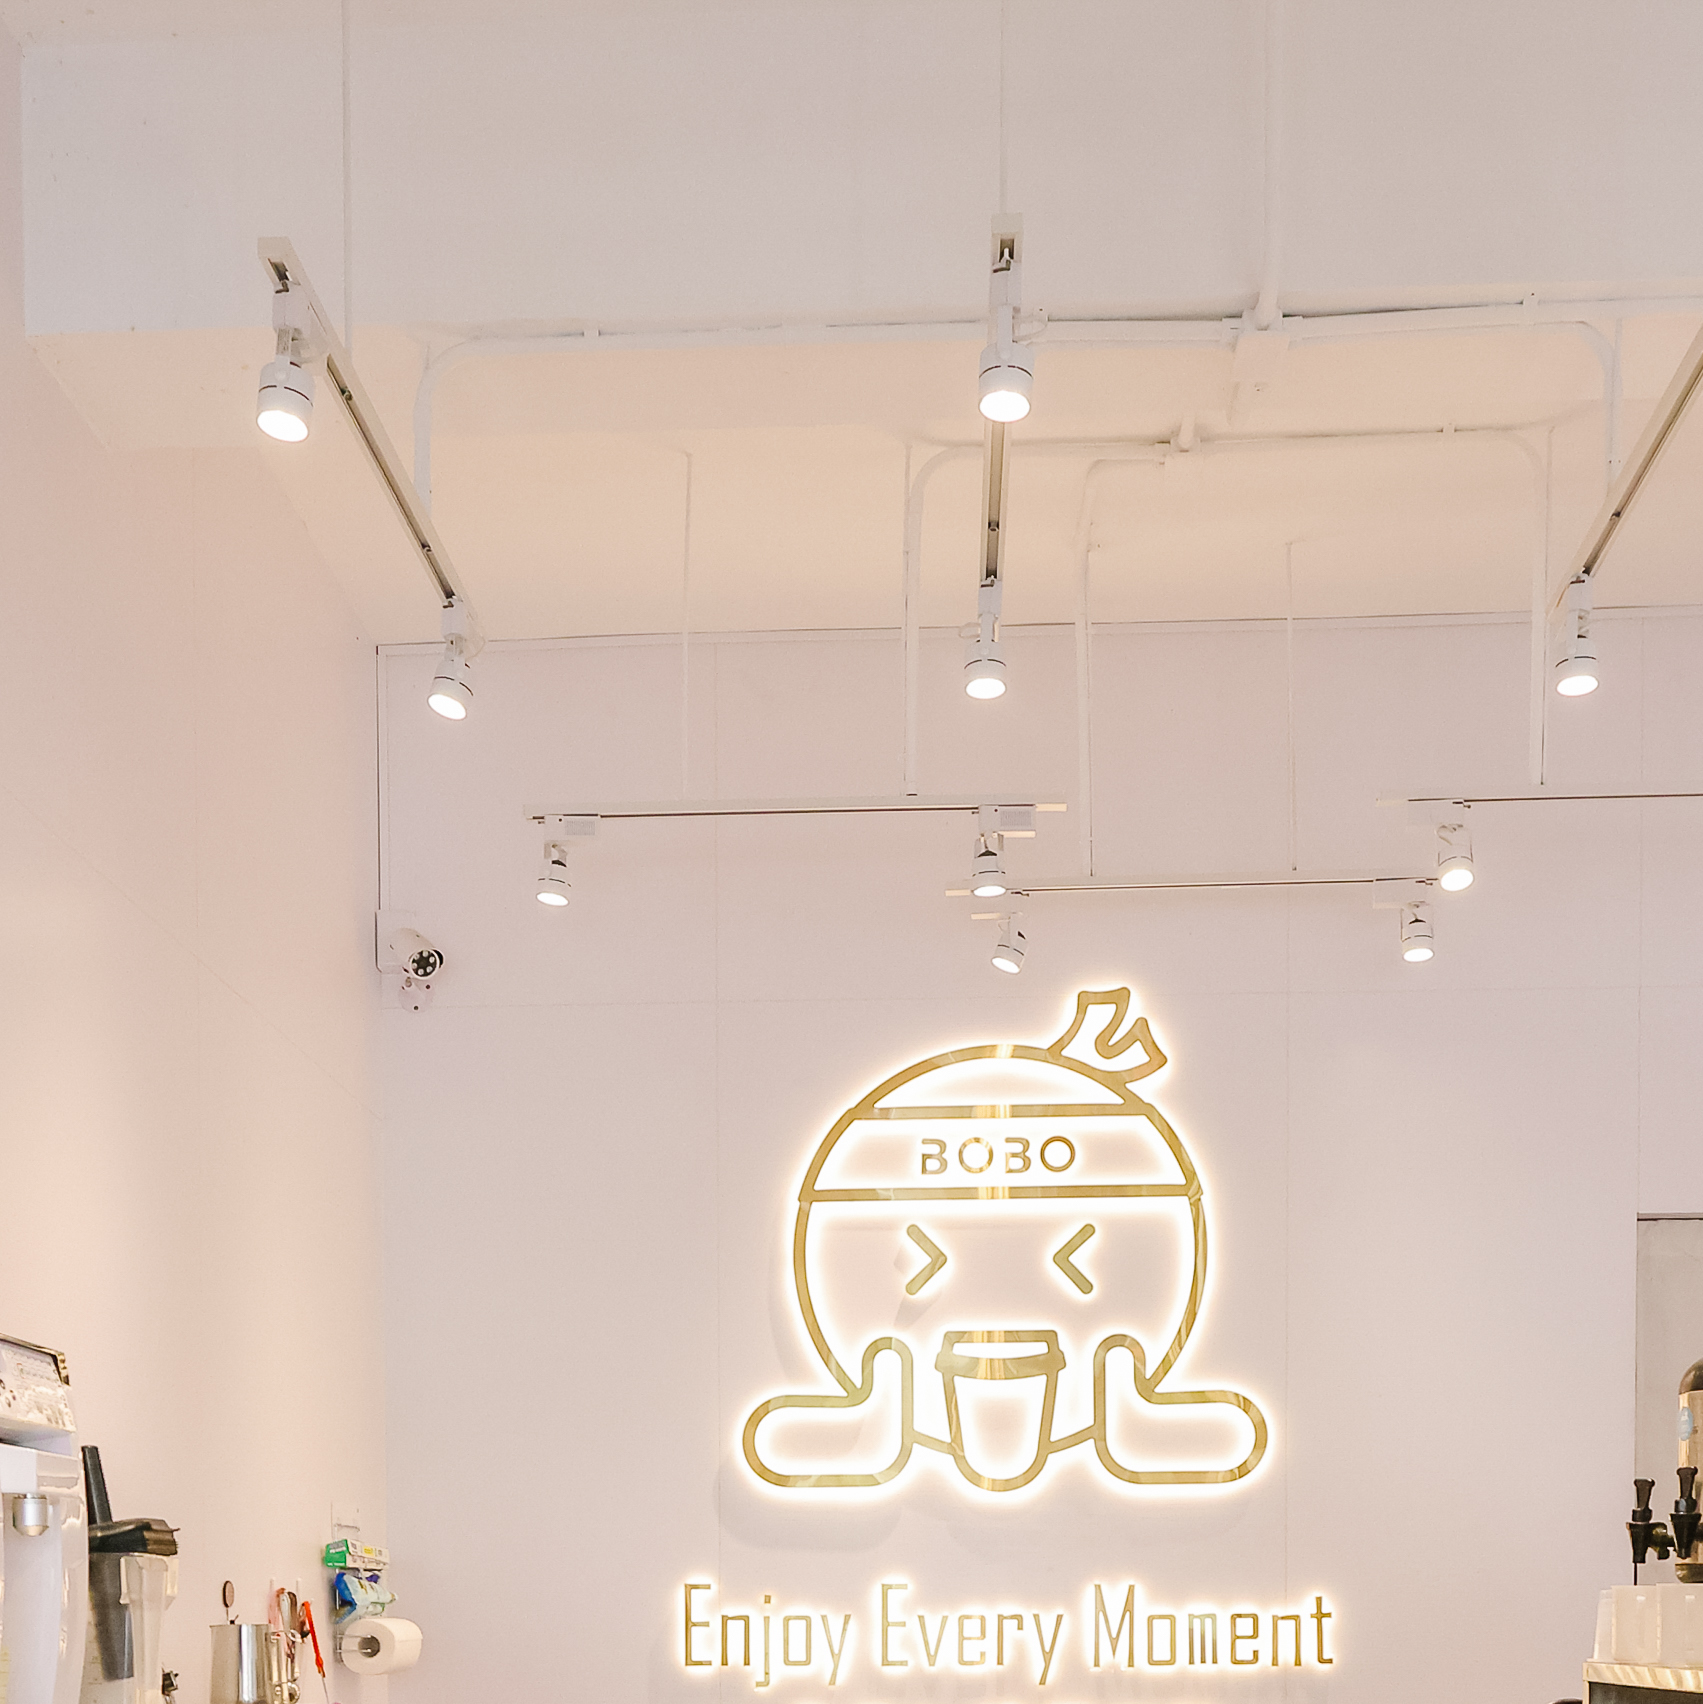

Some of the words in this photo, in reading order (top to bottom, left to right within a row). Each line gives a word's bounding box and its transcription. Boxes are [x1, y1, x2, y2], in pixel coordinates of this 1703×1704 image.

[920, 1136, 1076, 1175] BOBO
[683, 1583, 851, 1688] Enjoy
[880, 1583, 1063, 1686] Every
[1094, 1583, 1334, 1669] Moment
